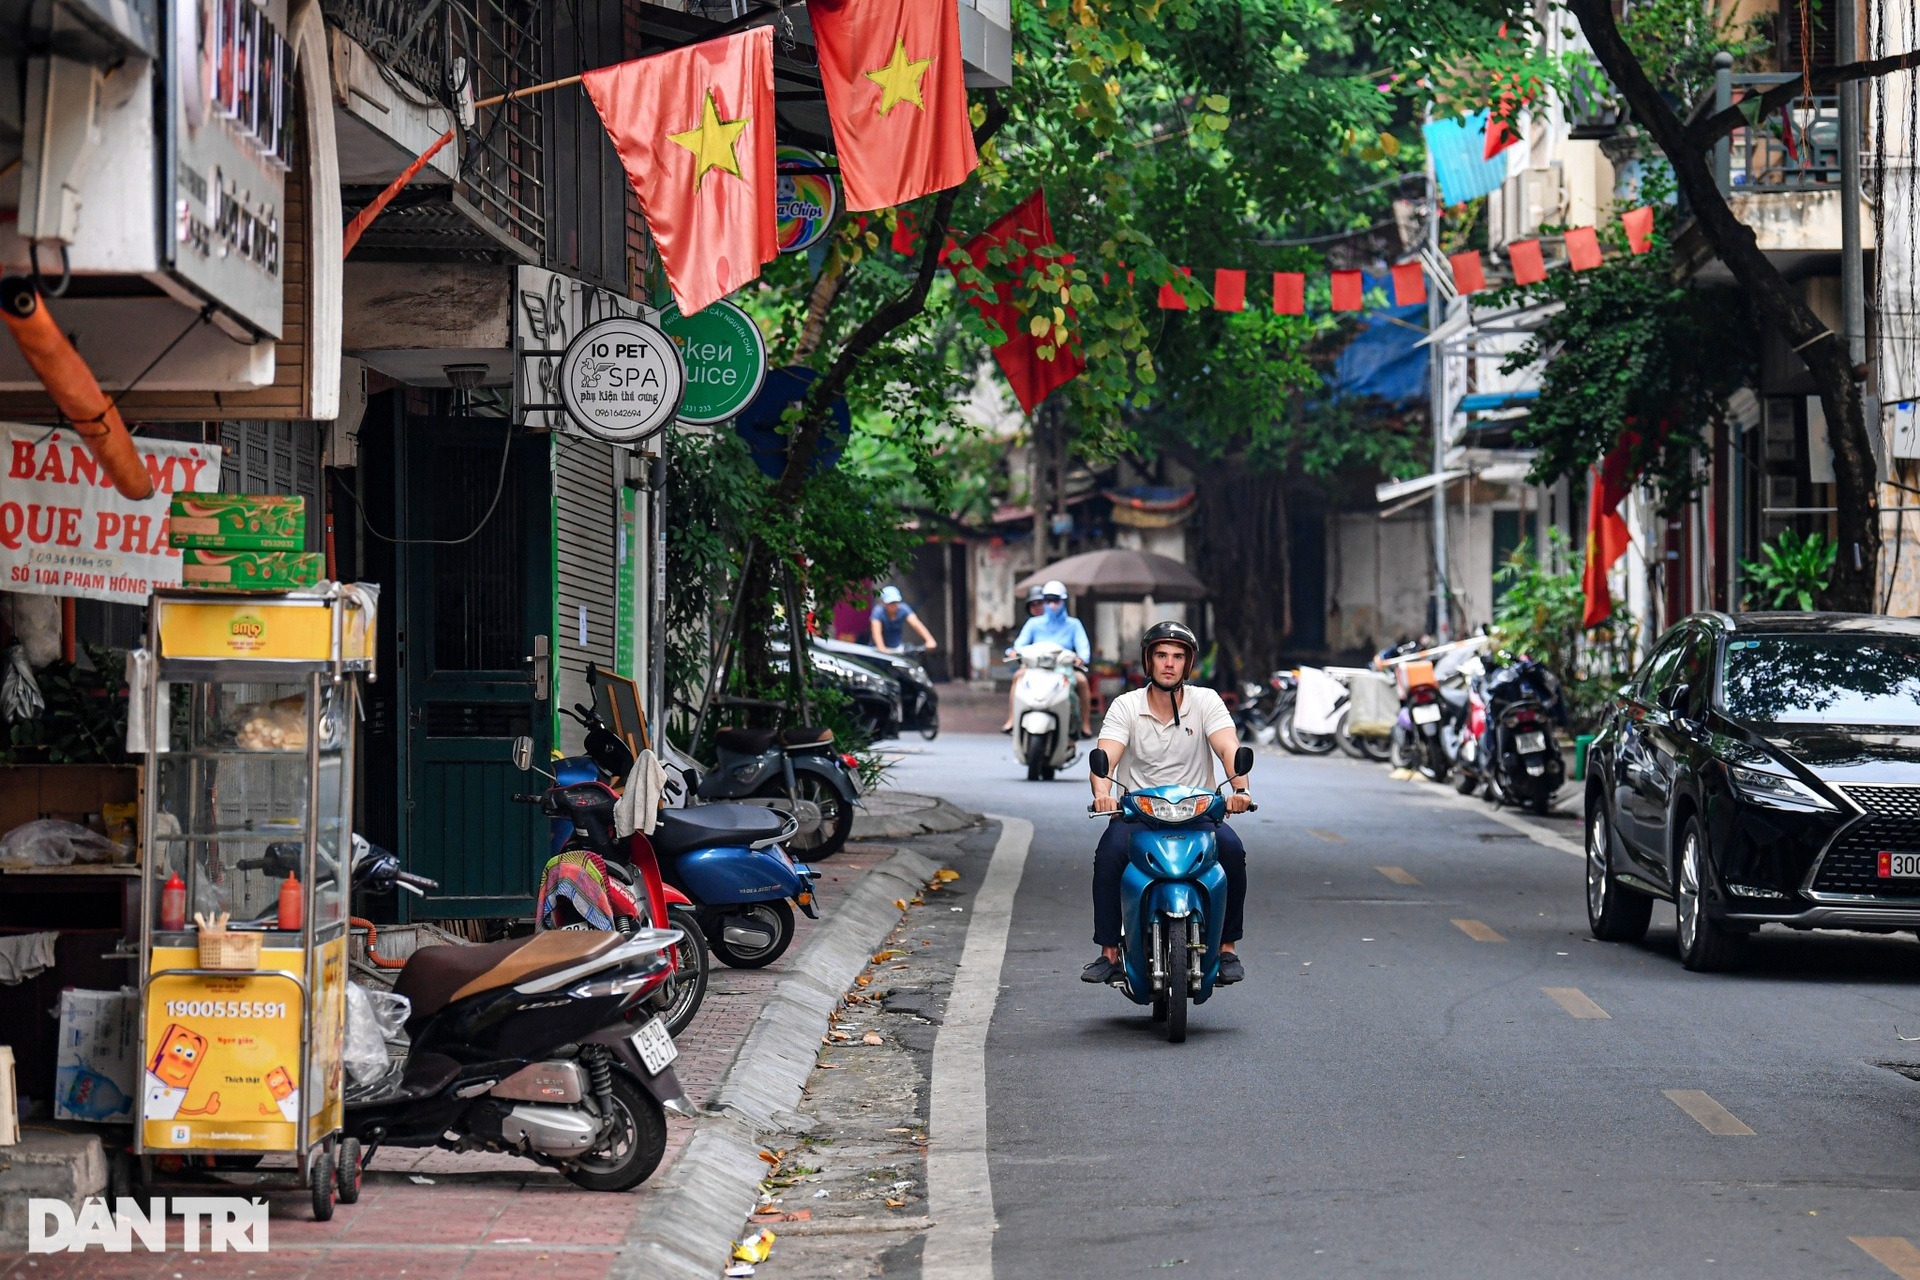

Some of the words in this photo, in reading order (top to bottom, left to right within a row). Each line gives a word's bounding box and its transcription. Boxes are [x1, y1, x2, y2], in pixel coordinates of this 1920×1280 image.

[790, 202, 823, 219] Chips
[616, 343, 648, 359] PET
[608, 367, 659, 388] SPA
[686, 361, 737, 386] uice
[595, 409, 642, 417] 0961642694
[684, 404, 696, 413] 331
[699, 404, 712, 413] 233
[8, 433, 116, 488] BÁN
[0, 501, 82, 550] QUE
[11, 561, 31, 582] SỐ
[35, 569, 59, 585] 10A
[64, 571, 105, 591] PHẠM
[166, 1001, 286, 1019] 1900555591
